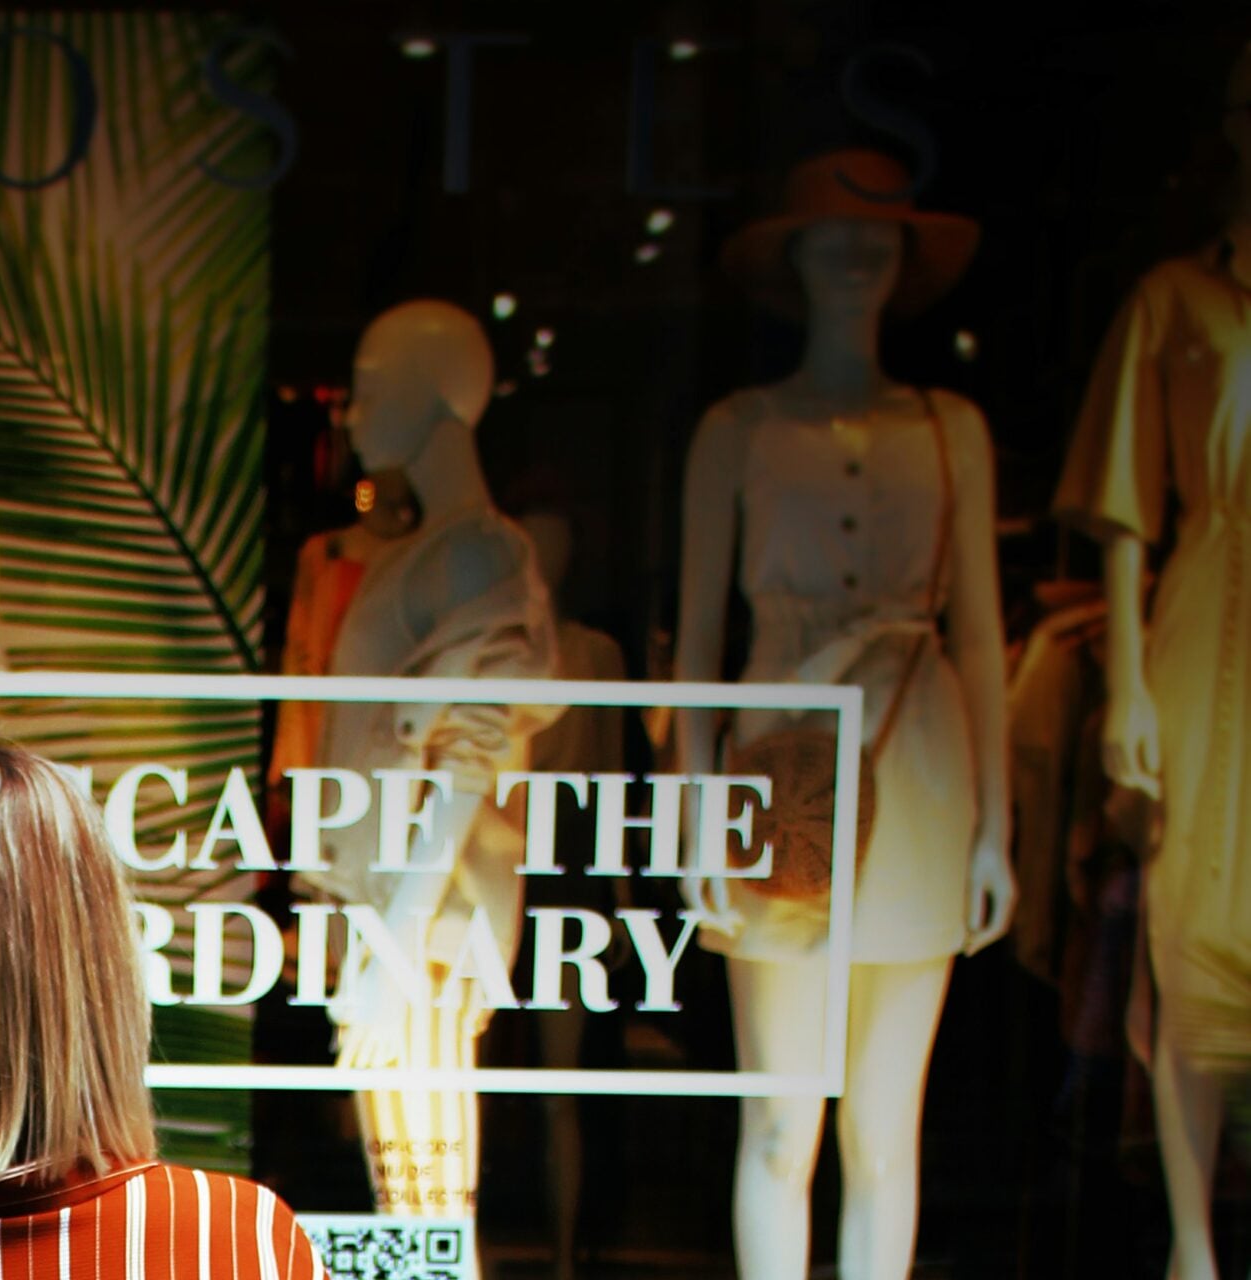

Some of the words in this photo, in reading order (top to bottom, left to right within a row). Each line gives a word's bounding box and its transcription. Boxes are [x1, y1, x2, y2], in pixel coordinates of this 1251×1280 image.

[55, 762, 456, 873] CAPE
[495, 770, 773, 879] THE
[128, 900, 701, 1013] RDINARY
